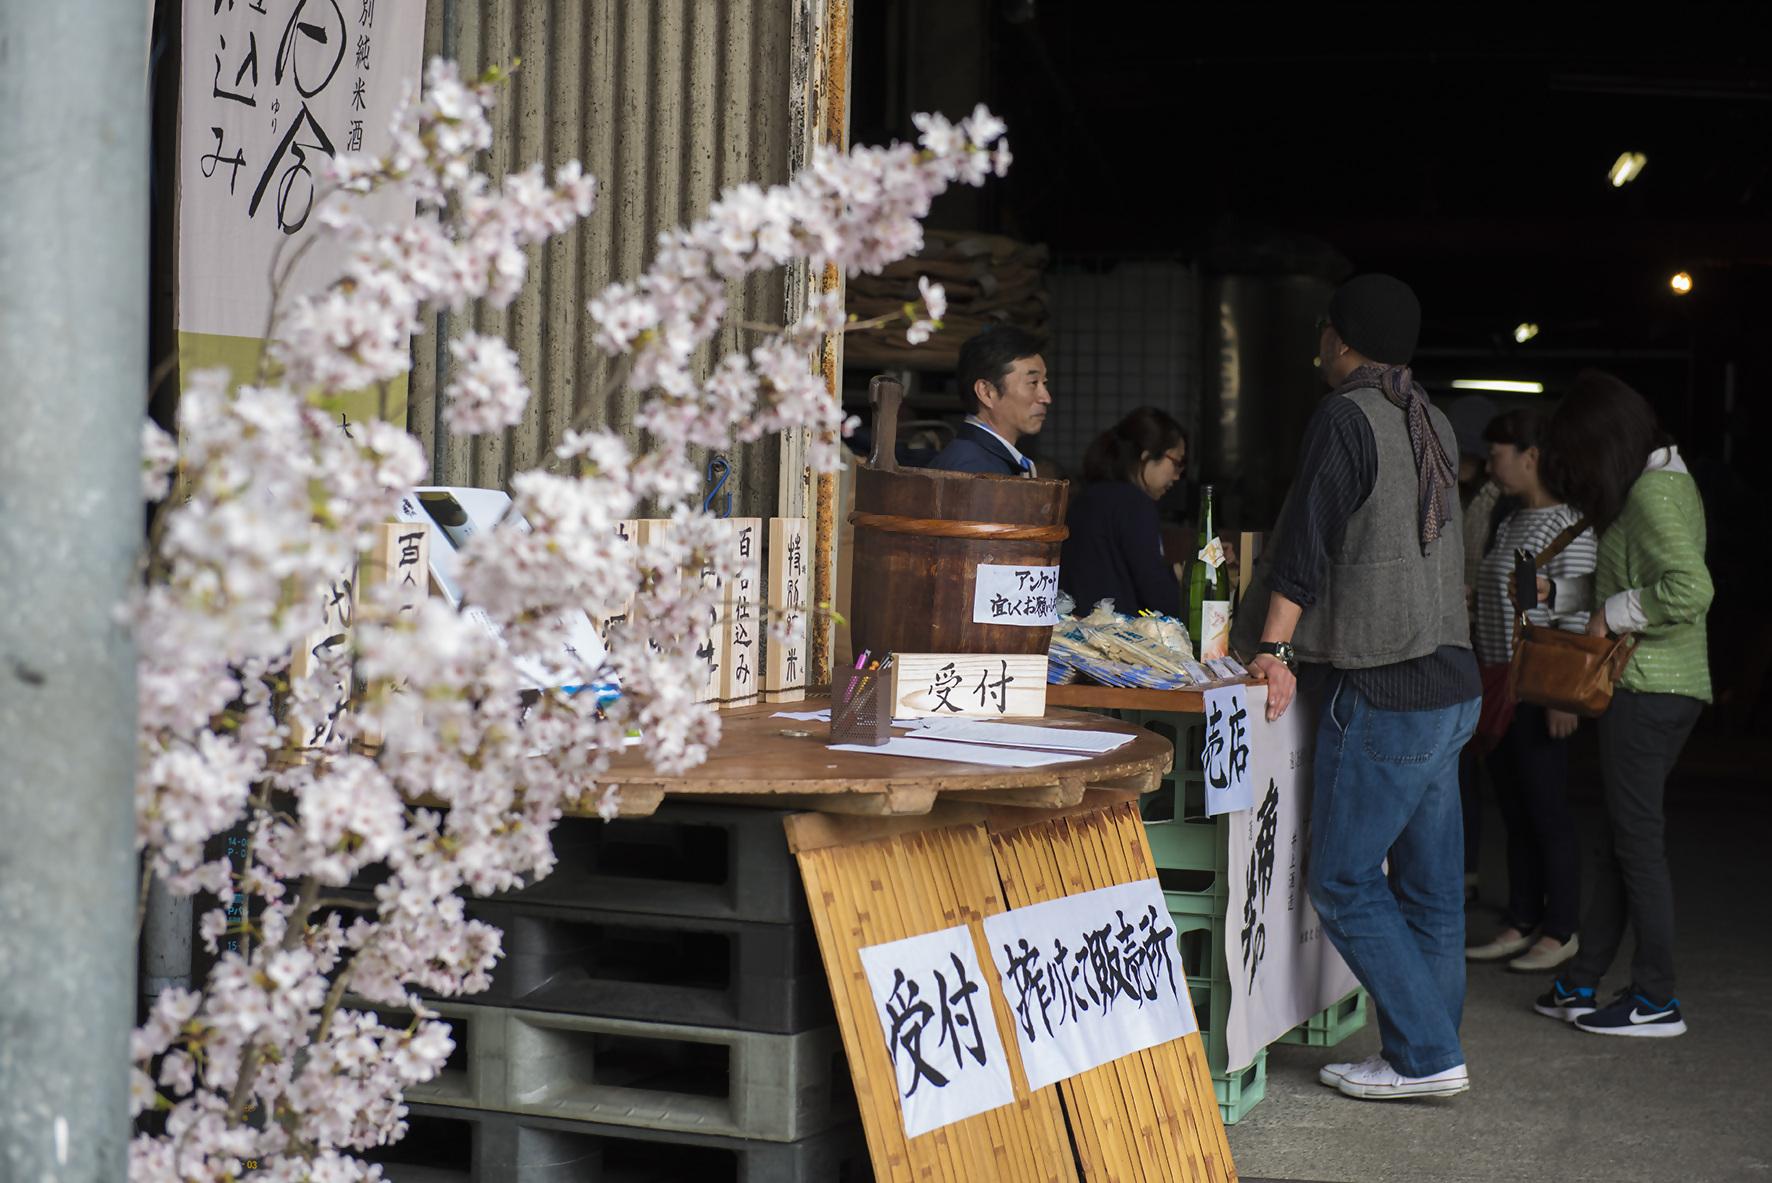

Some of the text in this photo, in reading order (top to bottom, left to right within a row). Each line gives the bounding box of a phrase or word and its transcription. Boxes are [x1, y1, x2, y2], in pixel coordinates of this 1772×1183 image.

[271, 99, 281, 134] ゆり
[927, 659, 1015, 715] 受付
[1200, 695, 1250, 791] 売店
[1003, 904, 1180, 1044] 搾りたて販売所
[885, 951, 979, 1099] 受付
